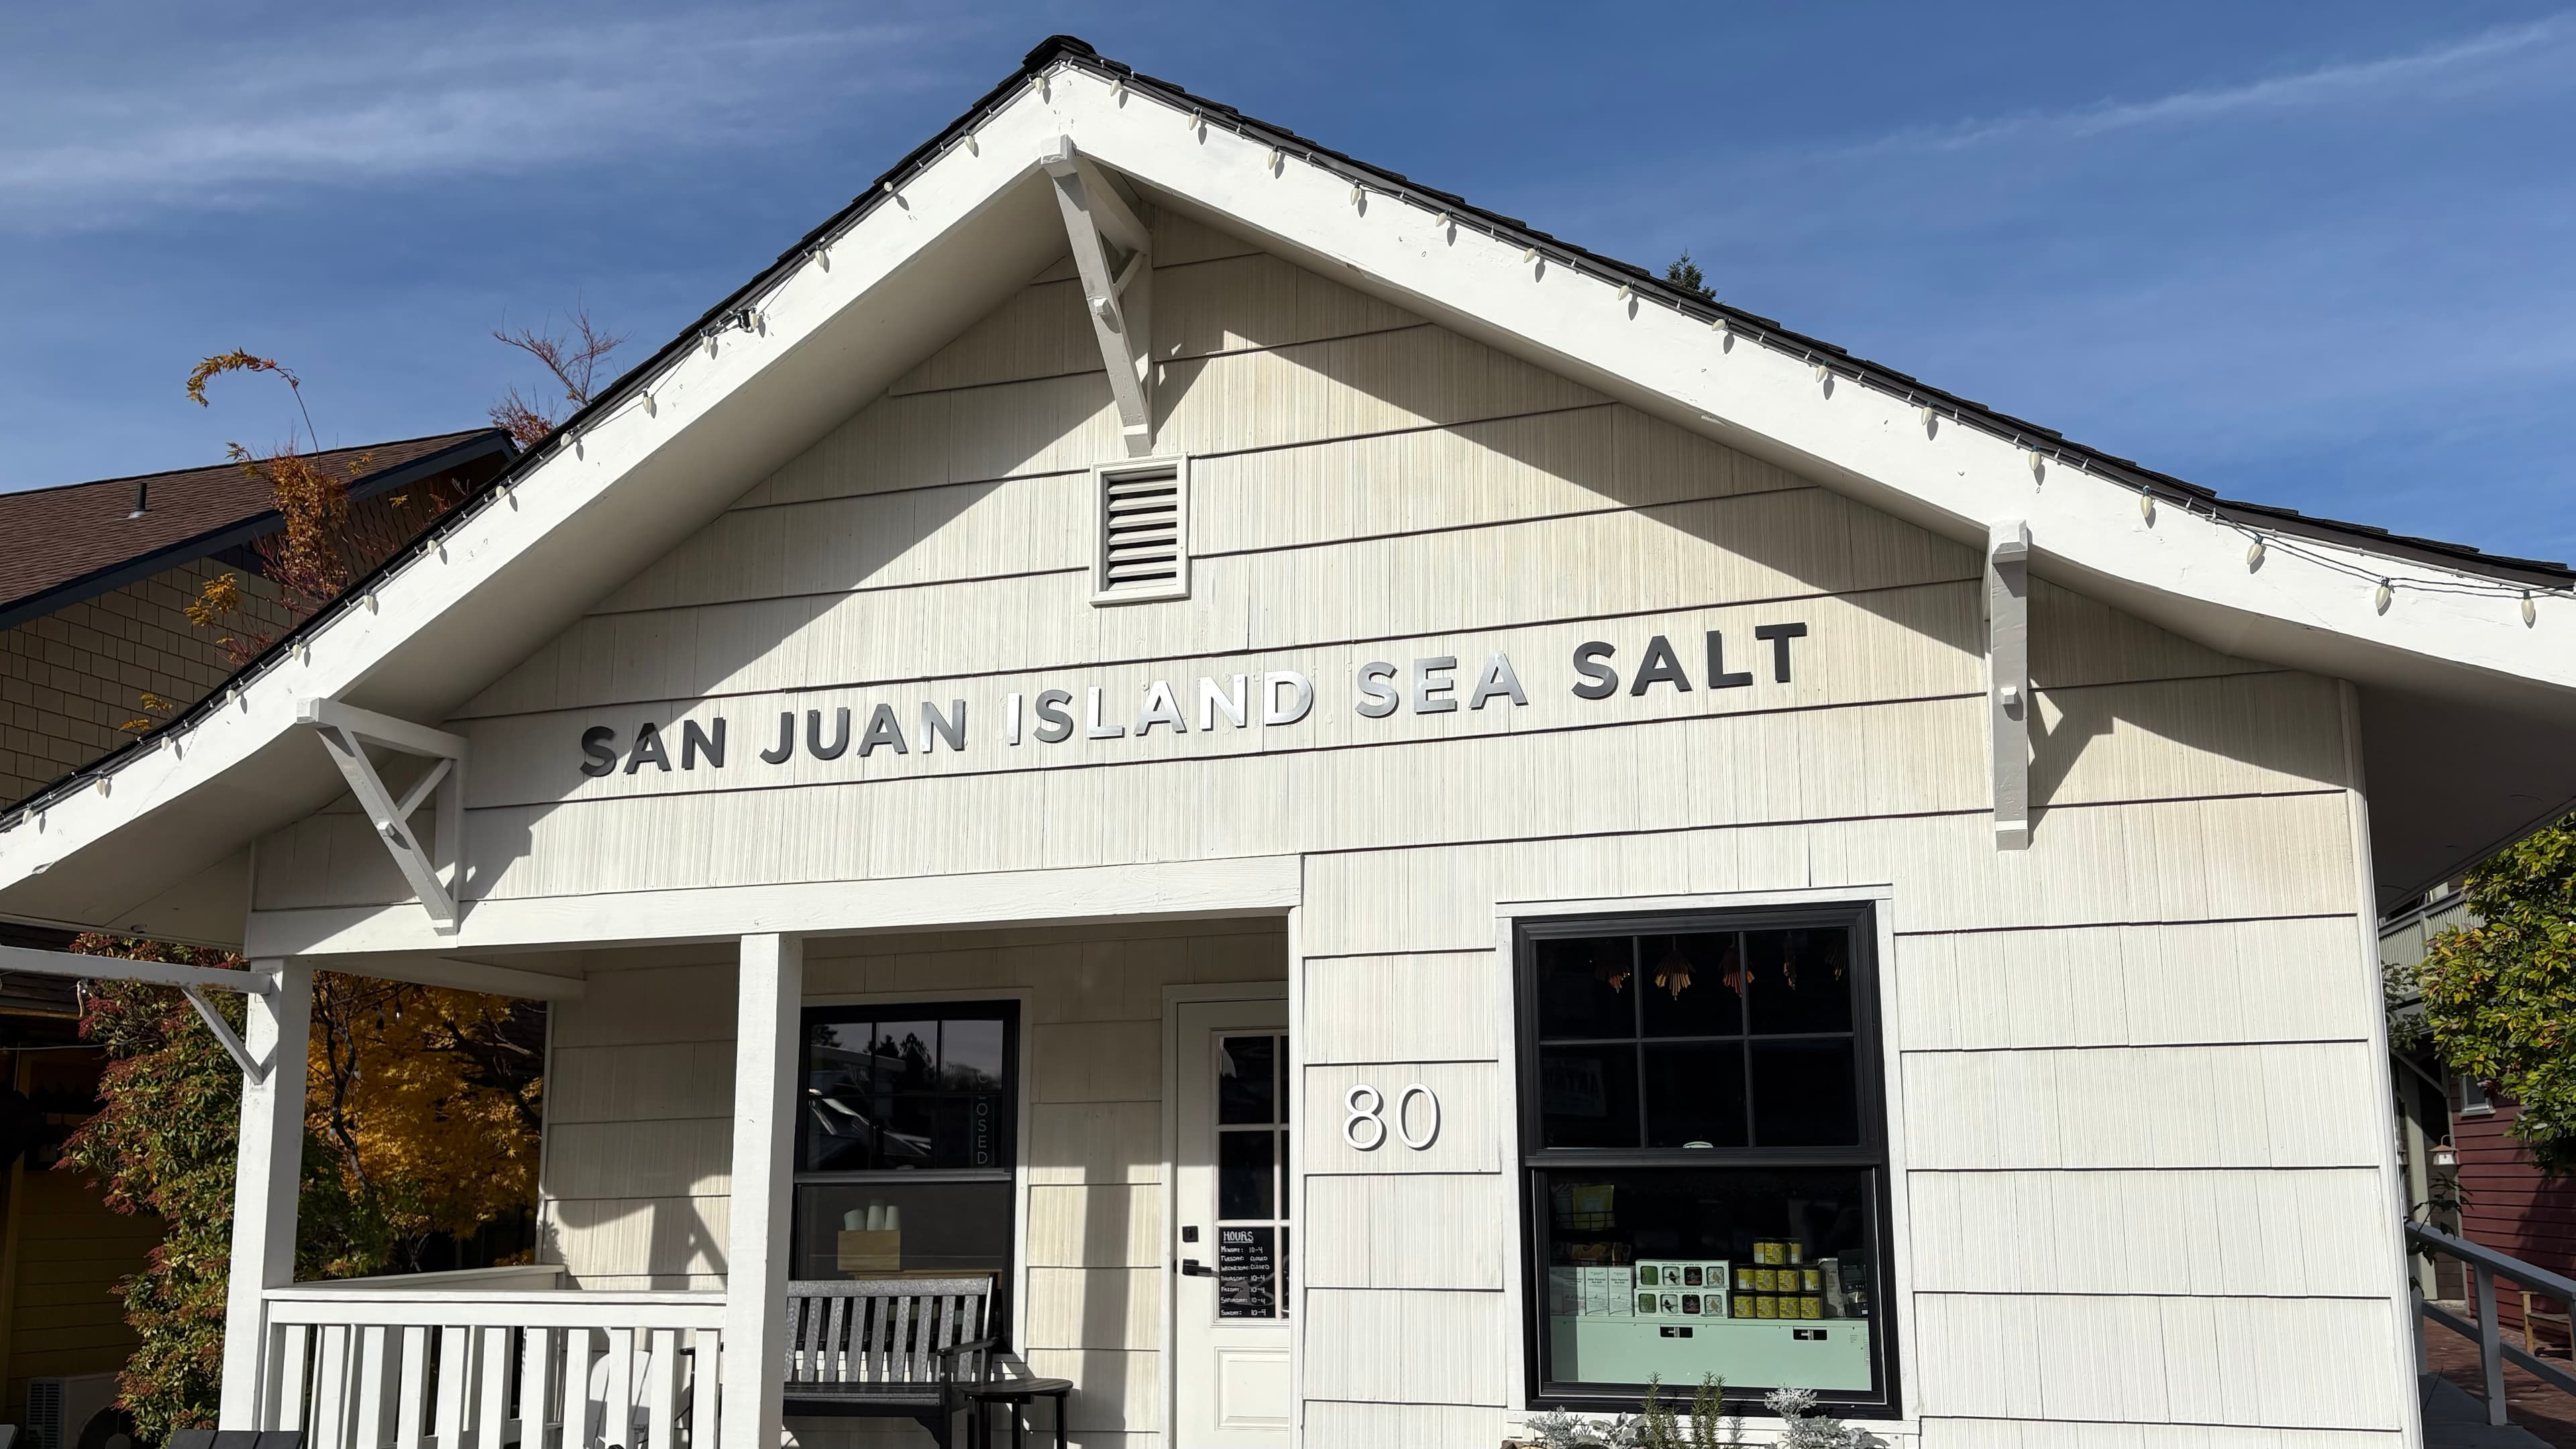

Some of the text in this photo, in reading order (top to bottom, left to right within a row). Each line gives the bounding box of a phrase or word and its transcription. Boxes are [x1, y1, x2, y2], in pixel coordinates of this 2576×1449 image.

[580, 622, 1807, 778] SAN JUAN ISLAND SEA SALT
[1342, 1083, 1441, 1152] 80
[1223, 1231, 1254, 1242] HOURS
